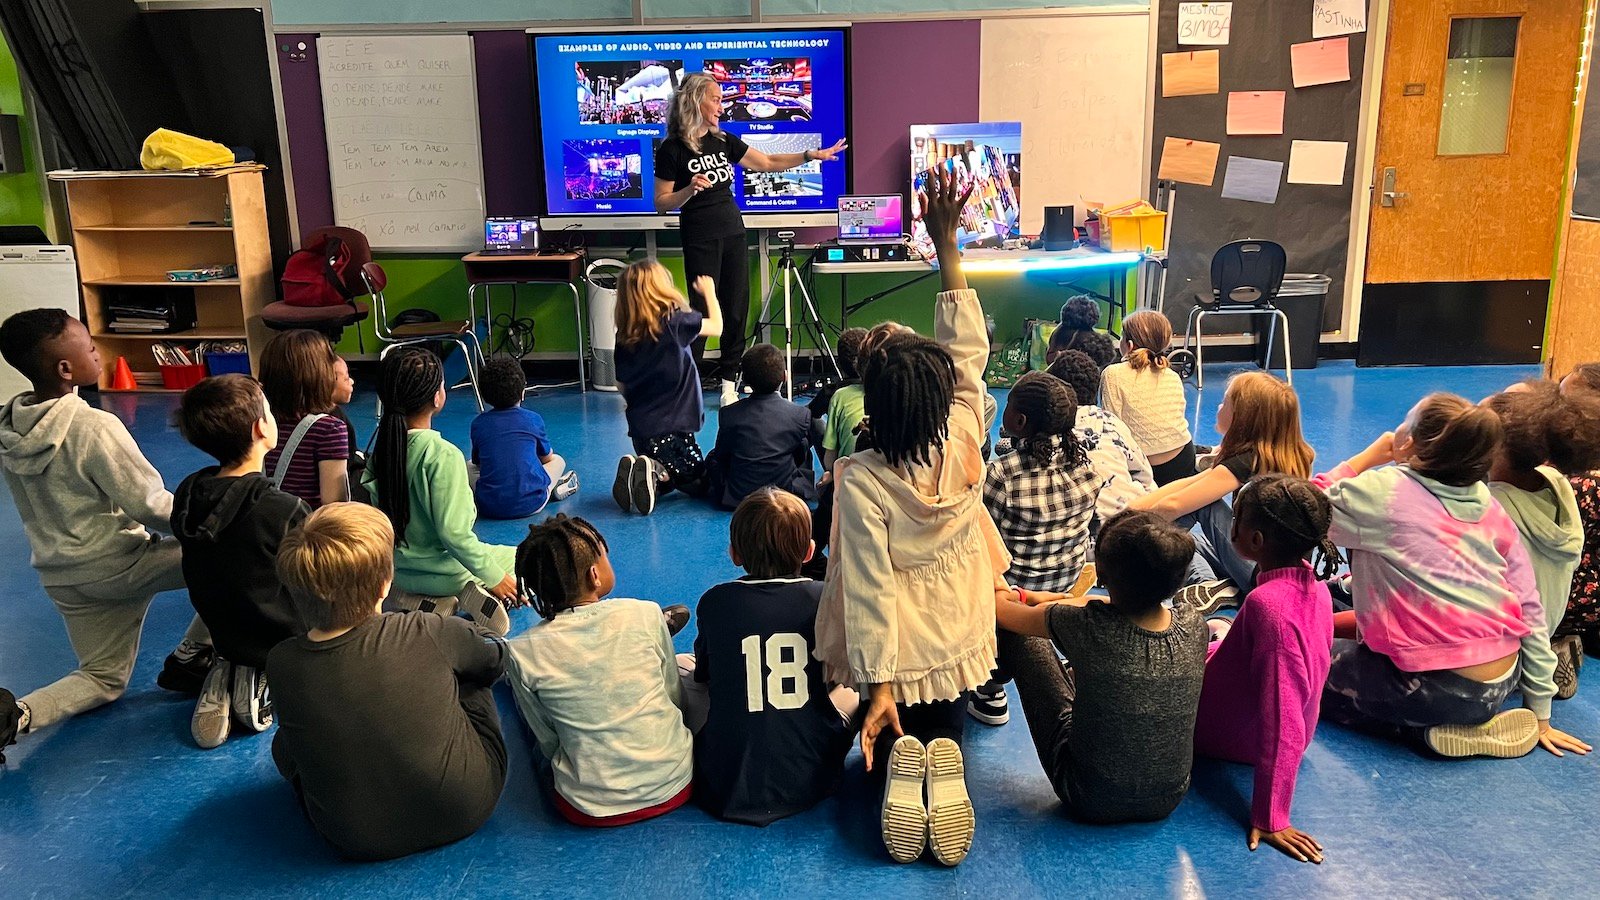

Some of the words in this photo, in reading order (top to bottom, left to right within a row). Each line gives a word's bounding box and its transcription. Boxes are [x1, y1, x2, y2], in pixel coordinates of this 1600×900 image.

[1181, 4, 1225, 16] MESTRE
[1315, 4, 1364, 30] PASTINHA
[1179, 16, 1232, 39] BIMBA
[558, 44, 603, 52] EXAMPLES
[605, 43, 618, 51] OF
[620, 43, 652, 51] AUDIO,
[654, 42, 682, 50] VIDEO
[684, 41, 704, 50] AND
[706, 40, 768, 49] EXPERIENTIAL
[770, 39, 829, 47] TECHNOLOGY
[328, 61, 374, 72] ACREDITE
[383, 59, 409, 70] QUEM
[417, 58, 451, 72] QUISER
[371, 143, 392, 153] TEM
[688, 152, 728, 173] GIRLS
[705, 166, 735, 185] OD
[741, 632, 809, 712] 18
